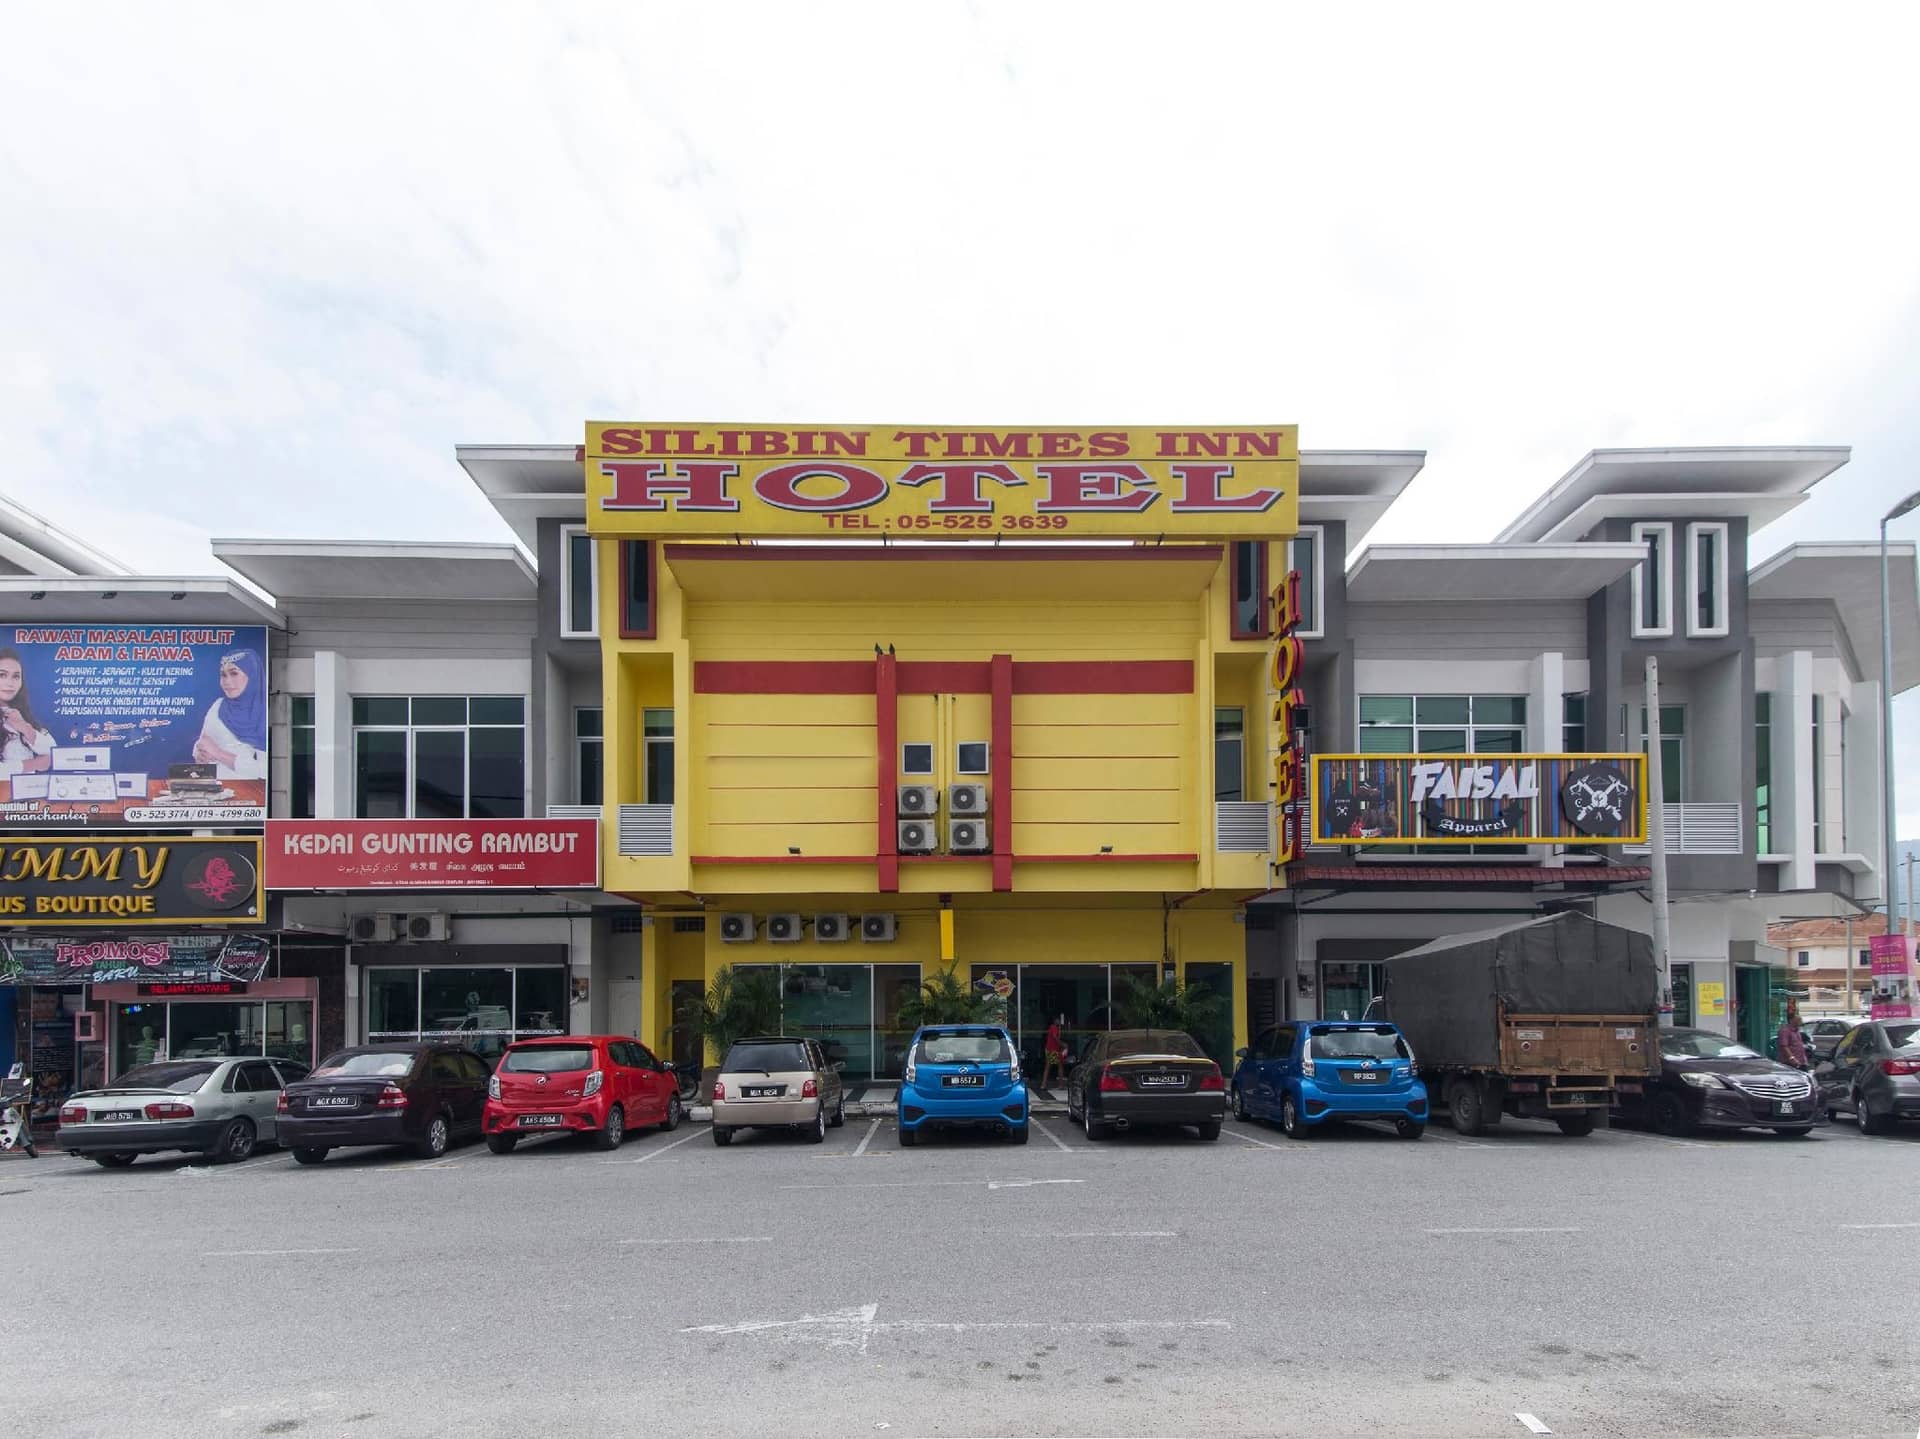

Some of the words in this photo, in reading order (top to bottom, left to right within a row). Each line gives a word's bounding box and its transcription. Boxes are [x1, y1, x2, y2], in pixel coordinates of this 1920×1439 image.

[601, 428, 870, 456] SILIBIN
[893, 432, 1131, 458] TIMES
[1155, 432, 1283, 457] INN
[600, 461, 1285, 513] HOTEL
[1001, 515, 1068, 529] 3639
[16, 629, 85, 643] RAWAT
[87, 629, 178, 644] MASALAH
[180, 630, 235, 645] KULIT
[54, 646, 112, 660] ADAM
[116, 647, 129, 660] &
[132, 646, 194, 661] HAWA
[141, 667, 164, 676] KULIT
[61, 677, 84, 685] KULIT
[85, 677, 113, 686] KUSAM
[119, 677, 141, 685] KULIT
[142, 677, 177, 686] SENSITIF
[61, 697, 83, 705] KULIT
[159, 707, 186, 715] LEMAK
[1271, 568, 1305, 866] HOTEL
[1410, 762, 1539, 802] FAISAL
[130, 810, 142, 819] 05
[149, 810, 166, 819] 525
[168, 809, 189, 818] 3774
[198, 809, 213, 818] 019
[1438, 818, 1508, 834] Apparel
[284, 833, 353, 855] KEDAI
[362, 832, 473, 855] GUNTING
[481, 832, 579, 854] RAMBUT
[36, 895, 156, 916] BOUTIQUE
[56, 941, 170, 966] PROMOSI
[93, 966, 140, 982] BARU
